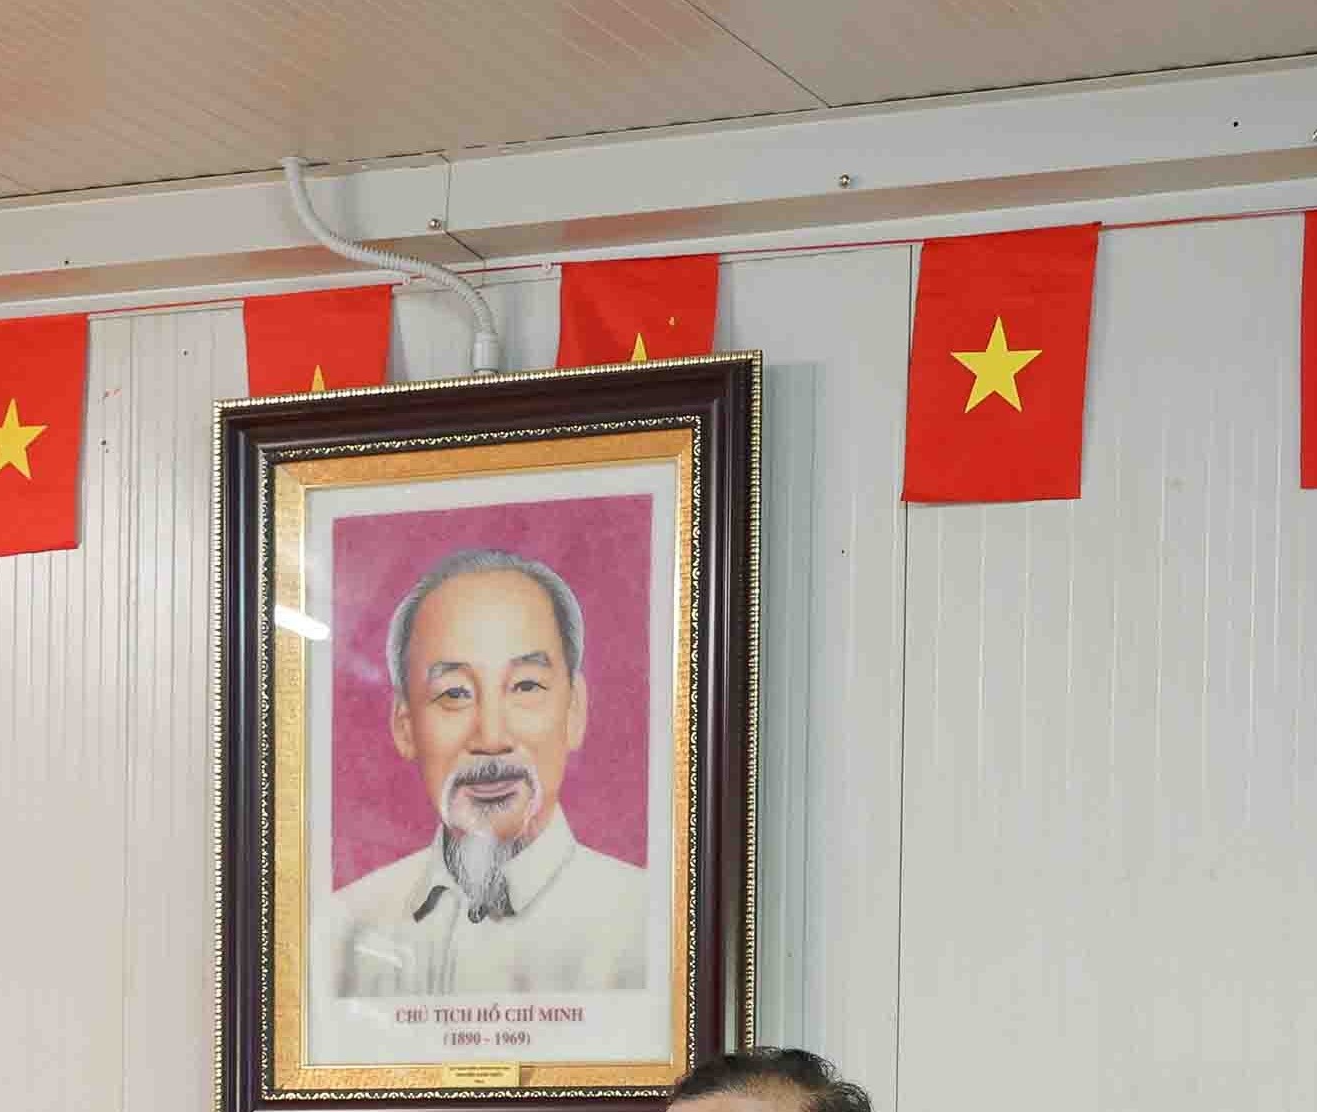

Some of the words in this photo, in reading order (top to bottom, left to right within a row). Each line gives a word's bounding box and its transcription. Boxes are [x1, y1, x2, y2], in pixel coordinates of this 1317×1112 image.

[434, 1007, 472, 1025] TỊCH
[505, 1004, 533, 1022] CHÍ
[539, 1006, 584, 1022] MINH
[443, 1031, 482, 1046] (1890
[495, 1031, 531, 1046] 1969)
